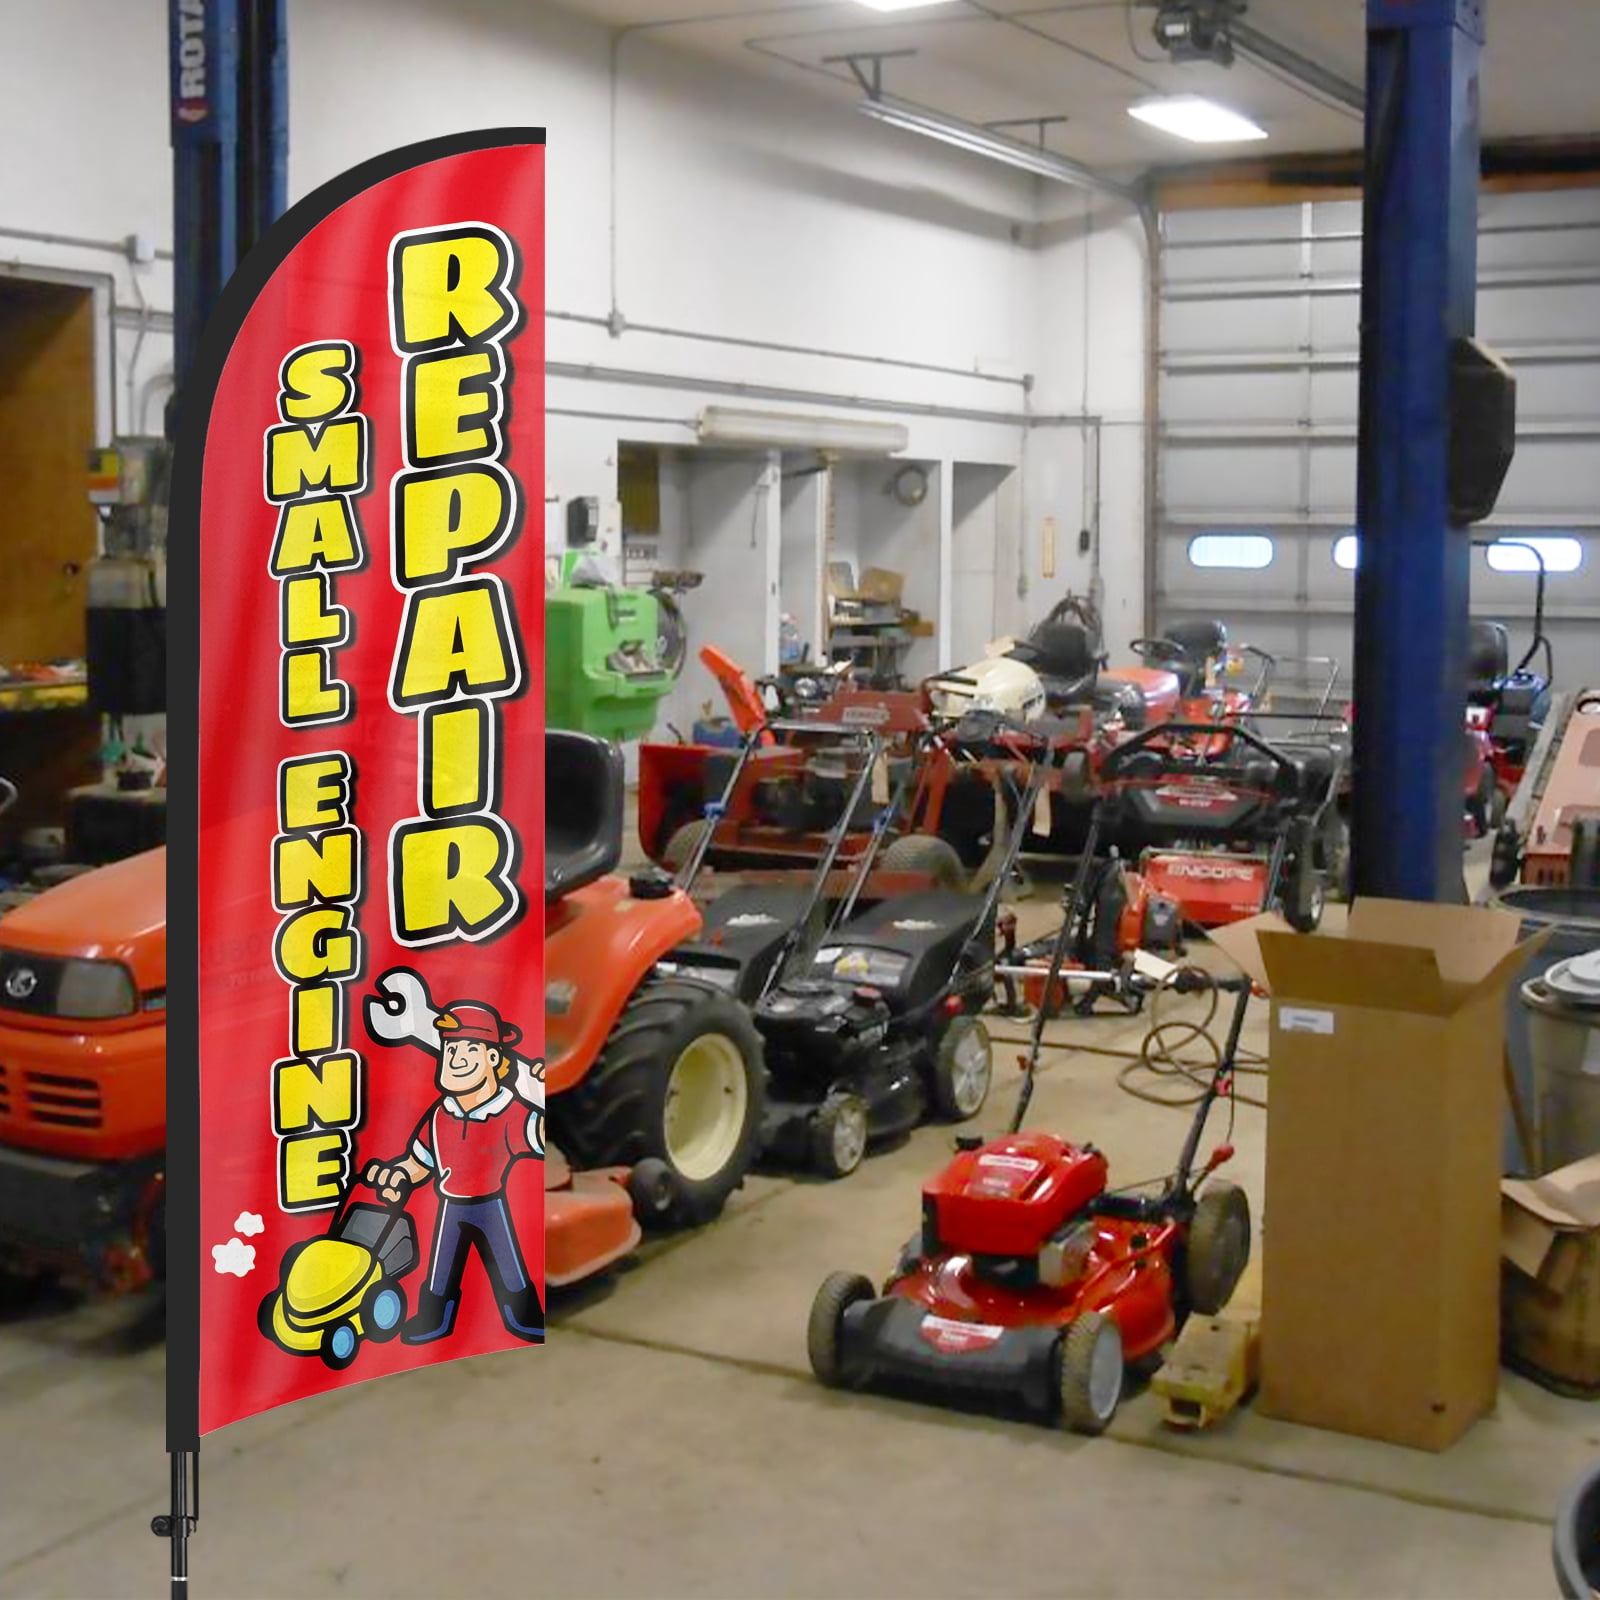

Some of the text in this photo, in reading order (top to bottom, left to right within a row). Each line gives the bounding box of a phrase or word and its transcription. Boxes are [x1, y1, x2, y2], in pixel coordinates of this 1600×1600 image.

[264, 340, 369, 1214] SMALL ENGINE
[387, 221, 522, 948] REPAIR
